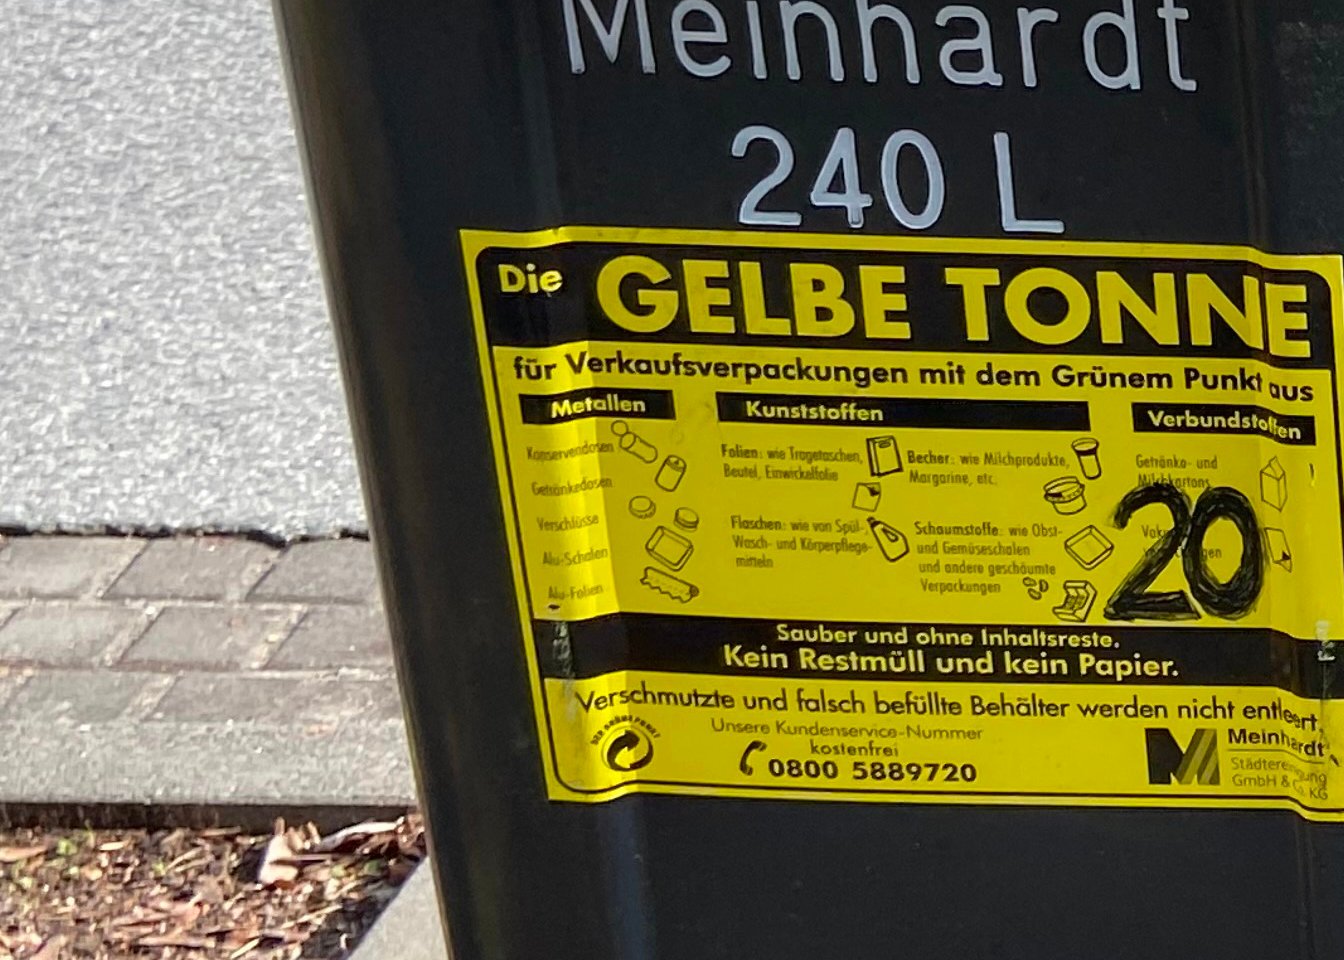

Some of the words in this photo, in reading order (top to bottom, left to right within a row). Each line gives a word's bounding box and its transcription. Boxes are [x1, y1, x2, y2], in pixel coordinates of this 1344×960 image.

[731, 125, 946, 230] 240
[994, 132, 1065, 233] L
[499, 263, 563, 295] Die
[597, 254, 912, 339] GELBE
[944, 266, 1312, 358] TONNE
[514, 356, 557, 381] für
[566, 351, 908, 388] Verkaufsverpackungen
[919, 362, 965, 386] mit
[976, 362, 1040, 387] dem
[1053, 365, 1173, 390] Grünem
[1185, 368, 1262, 392] Punkt
[1269, 381, 1314, 402] aus
[551, 396, 646, 419] Metallen
[745, 400, 884, 422] Kunststoffen
[1148, 409, 1302, 440] Verbundstoffen
[767, 448, 785, 460] wie
[789, 446, 863, 464] Tragetaschen,
[960, 453, 979, 465] wie
[984, 452, 1070, 468] Milchprodukte,
[1197, 455, 1218, 470] und
[909, 469, 974, 487] Margarine,
[790, 519, 809, 531] wie
[813, 521, 832, 532] von
[1008, 525, 1029, 536] wie
[1032, 523, 1063, 537] Obst-
[776, 538, 797, 551] und
[917, 541, 938, 554] und
[1104, 483, 1266, 621] 20
[919, 559, 940, 573] und
[944, 561, 985, 574] andere
[920, 578, 1001, 596] Verpackungen
[776, 623, 858, 645] Sauber
[865, 626, 908, 646] und
[916, 628, 973, 647] ohne
[981, 627, 1121, 649] Inhaltsreste.
[723, 644, 789, 670] Kein
[800, 648, 925, 674] Restmüll
[936, 651, 993, 674] und
[1004, 651, 1069, 676] kein
[1079, 652, 1179, 682] Papier.
[577, 680, 735, 715] Verschmutzte
[742, 688, 788, 712] und
[796, 688, 866, 714] falsch
[873, 690, 963, 716] befüllte
[971, 693, 1070, 718] Behälter
[1076, 695, 1169, 721] werden
[1178, 696, 1236, 721] nicht
[710, 717, 770, 737] Unsere
[775, 719, 984, 741] Kundenservice-Nummer
[810, 739, 900, 759] kostenfrei
[1228, 728, 1325, 757] Meinhardt
[768, 759, 839, 780] 0800
[852, 760, 977, 783] 5889720
[1232, 774, 1277, 788] GmbH
[1280, 776, 1290, 787] &
[1309, 786, 1328, 800] KG
